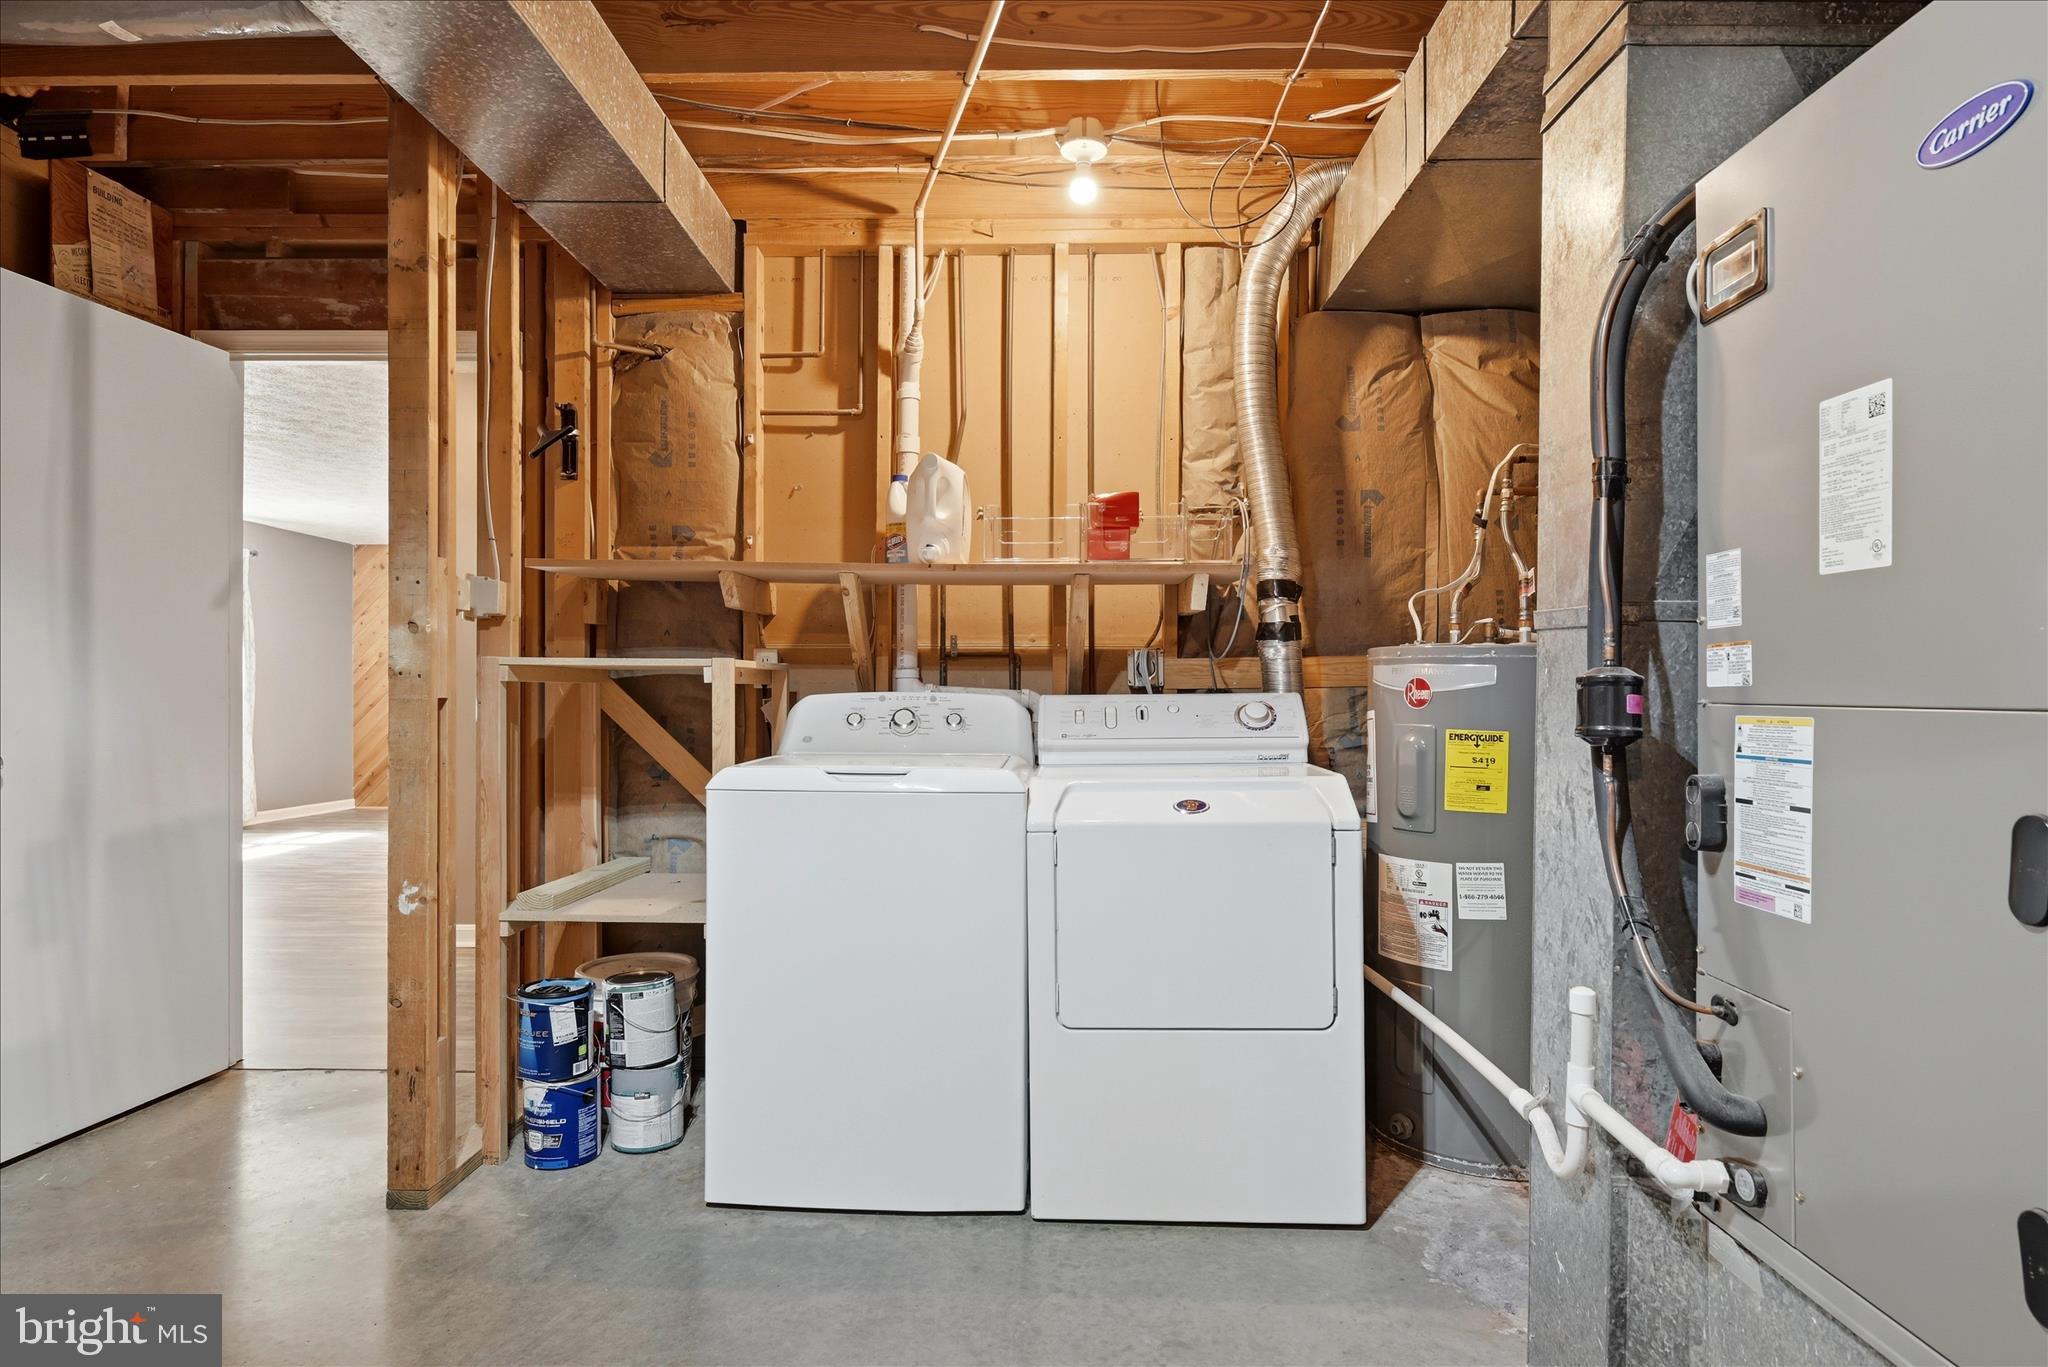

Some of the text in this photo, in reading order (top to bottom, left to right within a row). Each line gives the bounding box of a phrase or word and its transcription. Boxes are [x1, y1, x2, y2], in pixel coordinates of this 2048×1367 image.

[1929, 94, 2012, 154] Carrier
[92, 185, 123, 207] BUILDING
[74, 274, 91, 288] ELECT
[1408, 679, 1431, 704] Rheem
[1449, 733, 1504, 743] ENERGYGUIDE
